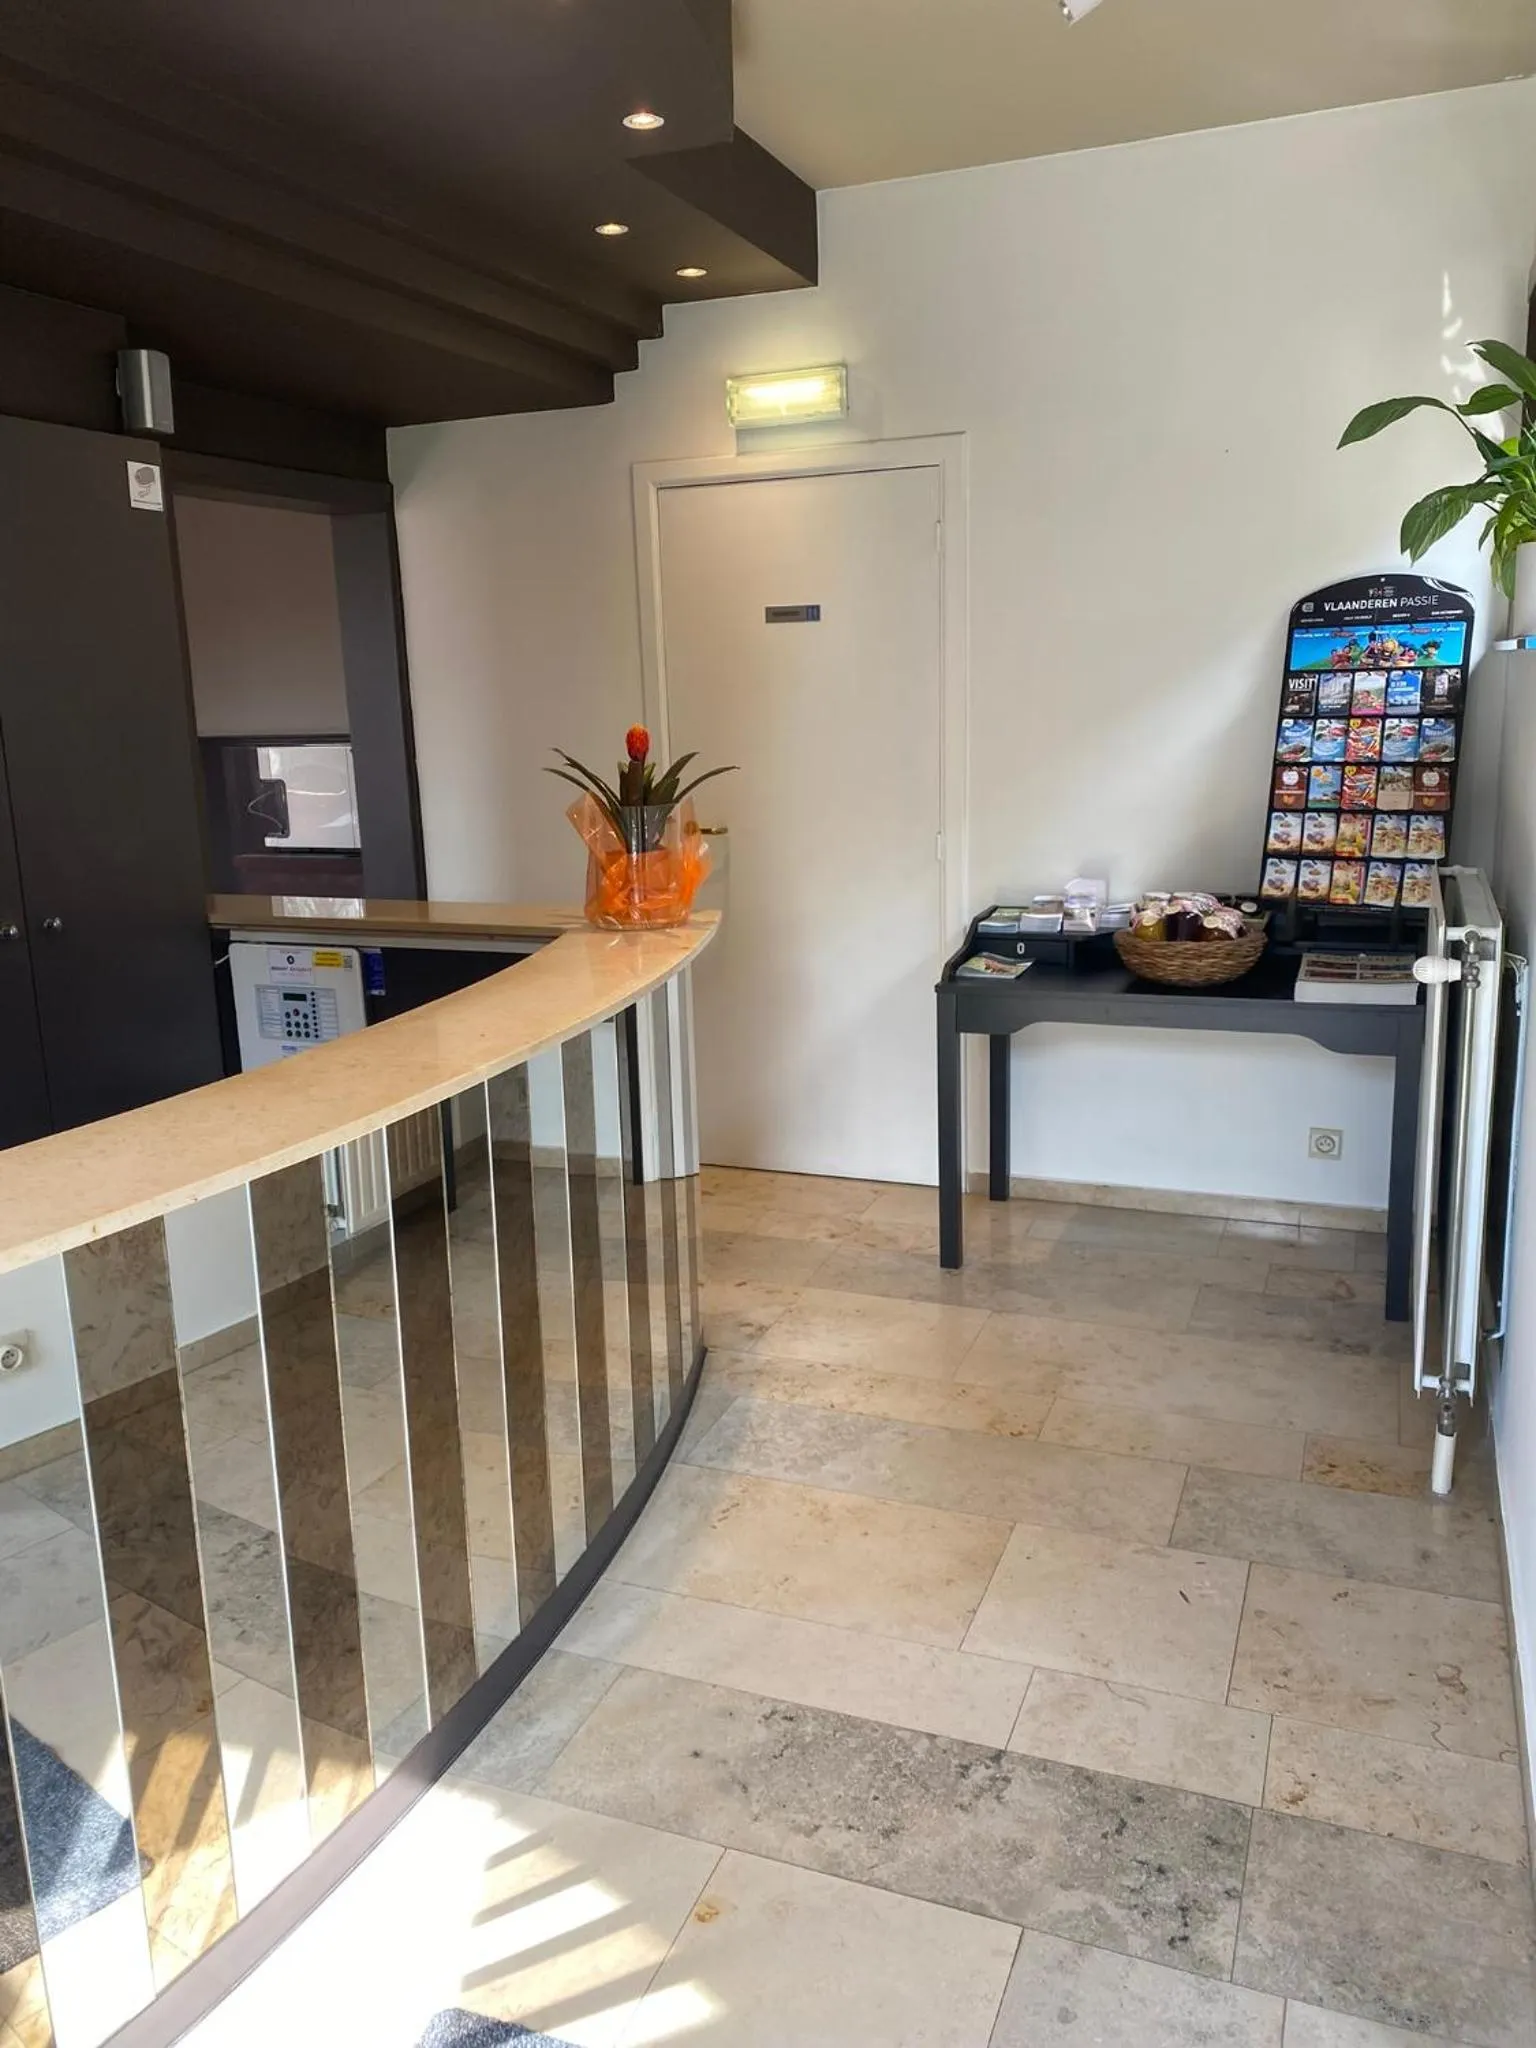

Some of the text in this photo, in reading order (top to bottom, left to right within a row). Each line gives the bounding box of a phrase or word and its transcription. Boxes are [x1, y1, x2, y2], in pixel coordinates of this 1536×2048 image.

[1323, 595, 1439, 611] VLAANDEREN PASSIE
[1288, 677, 1313, 690] VISIT
